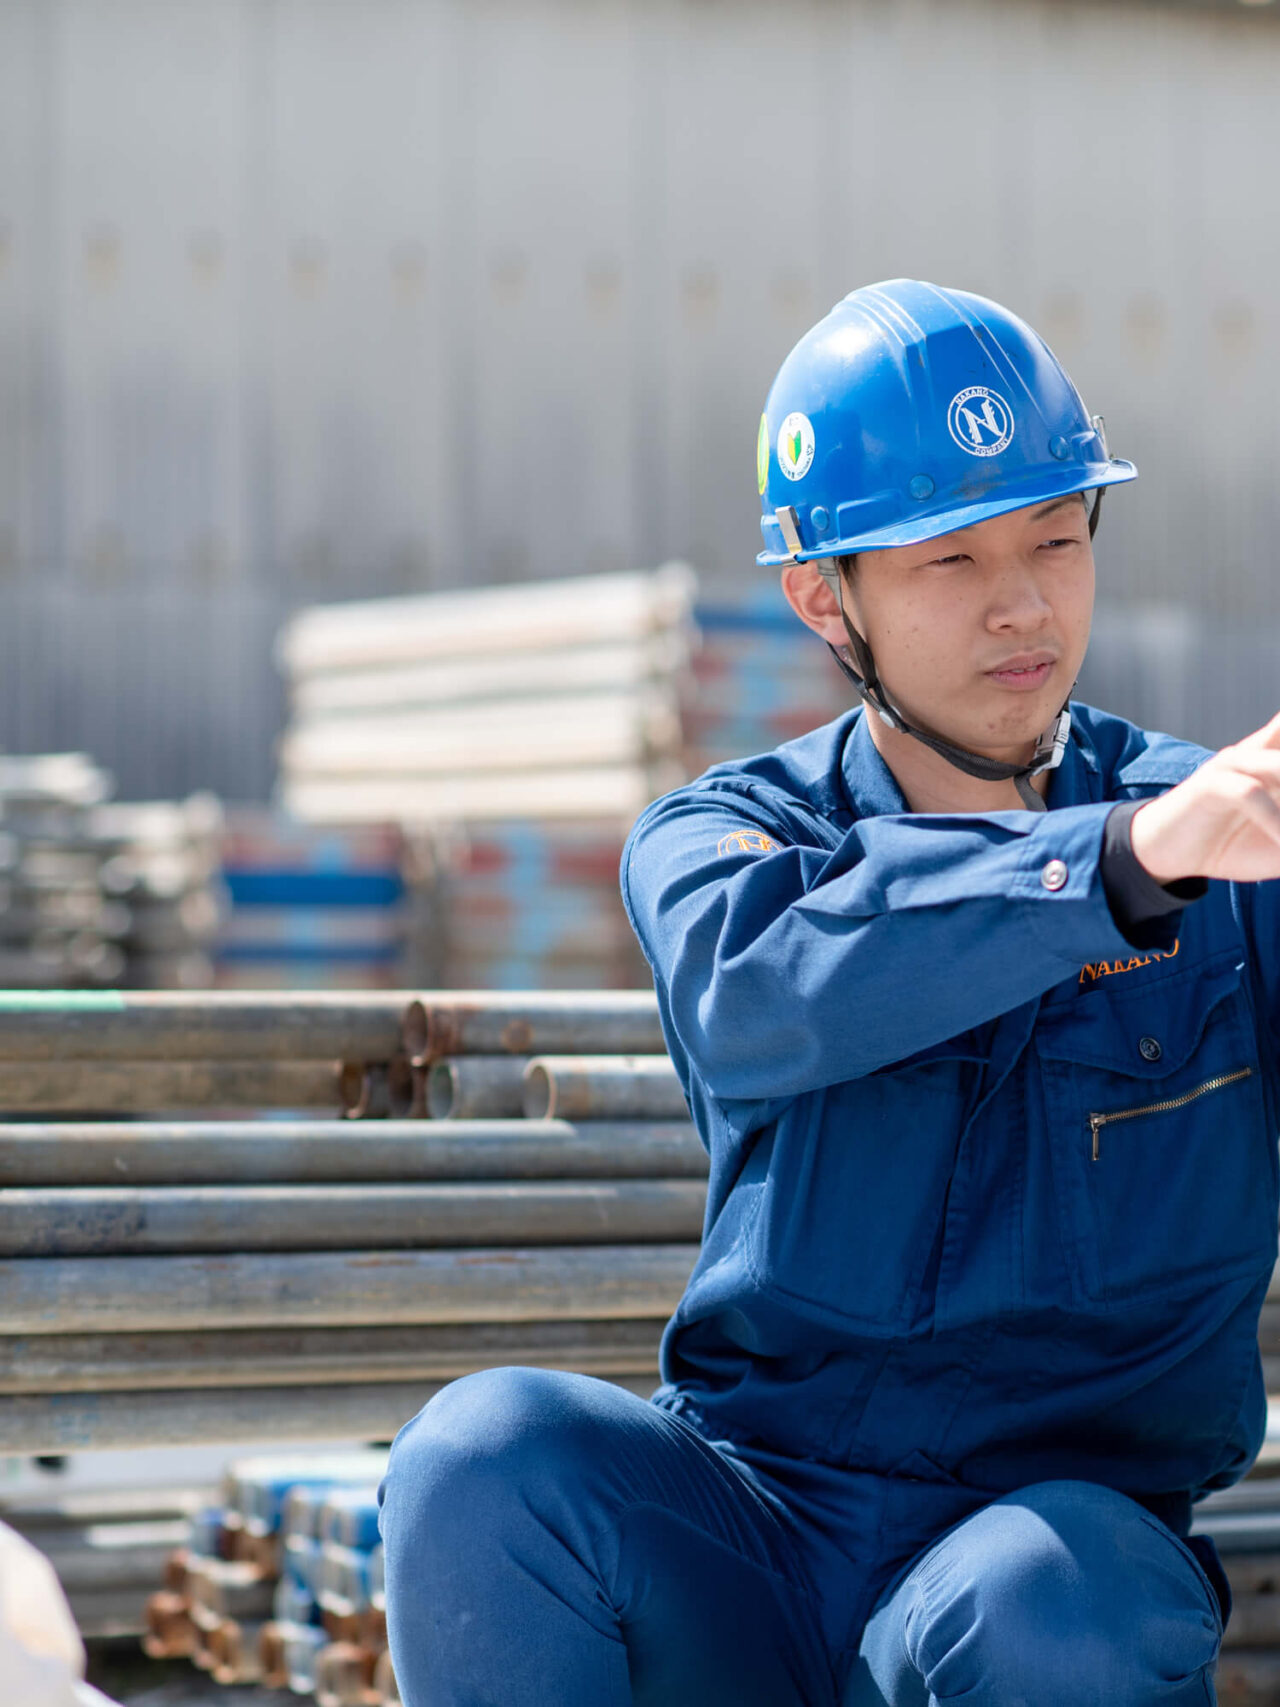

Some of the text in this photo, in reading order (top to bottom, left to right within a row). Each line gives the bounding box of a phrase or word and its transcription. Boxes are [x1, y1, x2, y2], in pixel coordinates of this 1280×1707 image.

[955, 388, 989, 405] NAKANO
[960, 399, 1003, 444] N
[975, 438, 1009, 455] COMPANY
